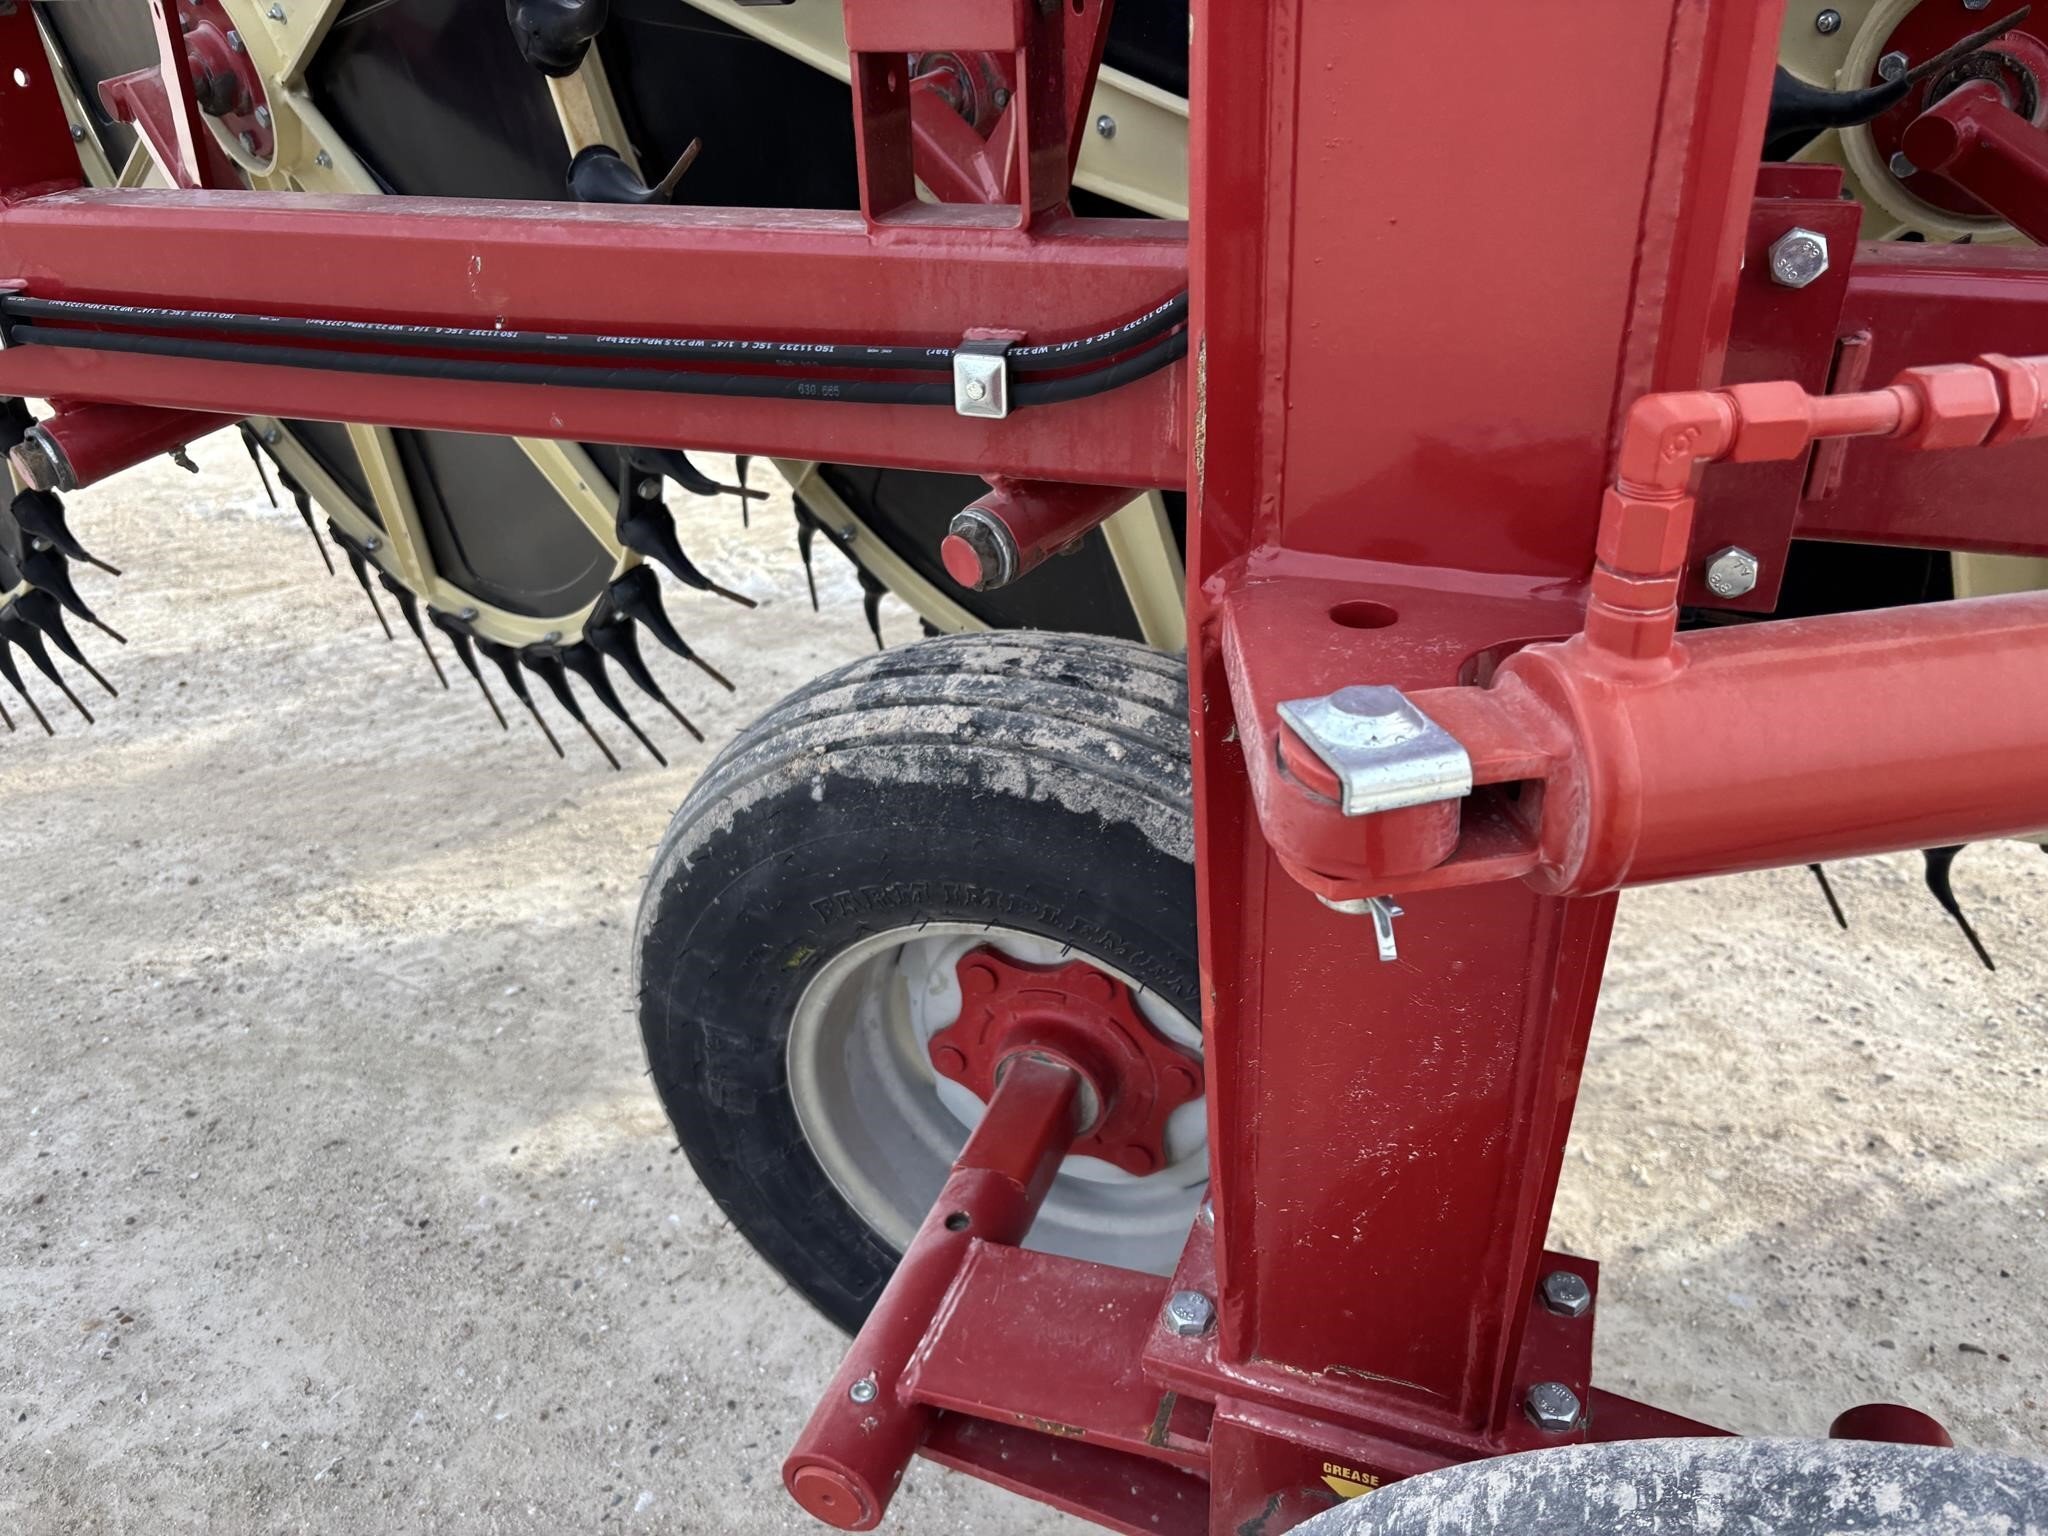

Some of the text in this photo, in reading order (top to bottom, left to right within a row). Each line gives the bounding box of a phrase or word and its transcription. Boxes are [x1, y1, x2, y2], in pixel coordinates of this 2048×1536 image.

[1803, 241, 1820, 258] 8.8
[1156, 298, 1174, 315] ISO
[1122, 310, 1154, 332] 11237
[597, 335, 835, 353] ISO 11237 1SC 6 1/4" WP 22.5 MPa (225 bar)
[1085, 337, 1093, 345] 6
[1097, 330, 1118, 342] 1SC
[925, 348, 950, 357] bar)
[1031, 345, 1049, 355] WP
[1056, 341, 1079, 352] 1/4"
[810, 881, 930, 925] FARM
[1323, 1462, 1380, 1487] GREASE
